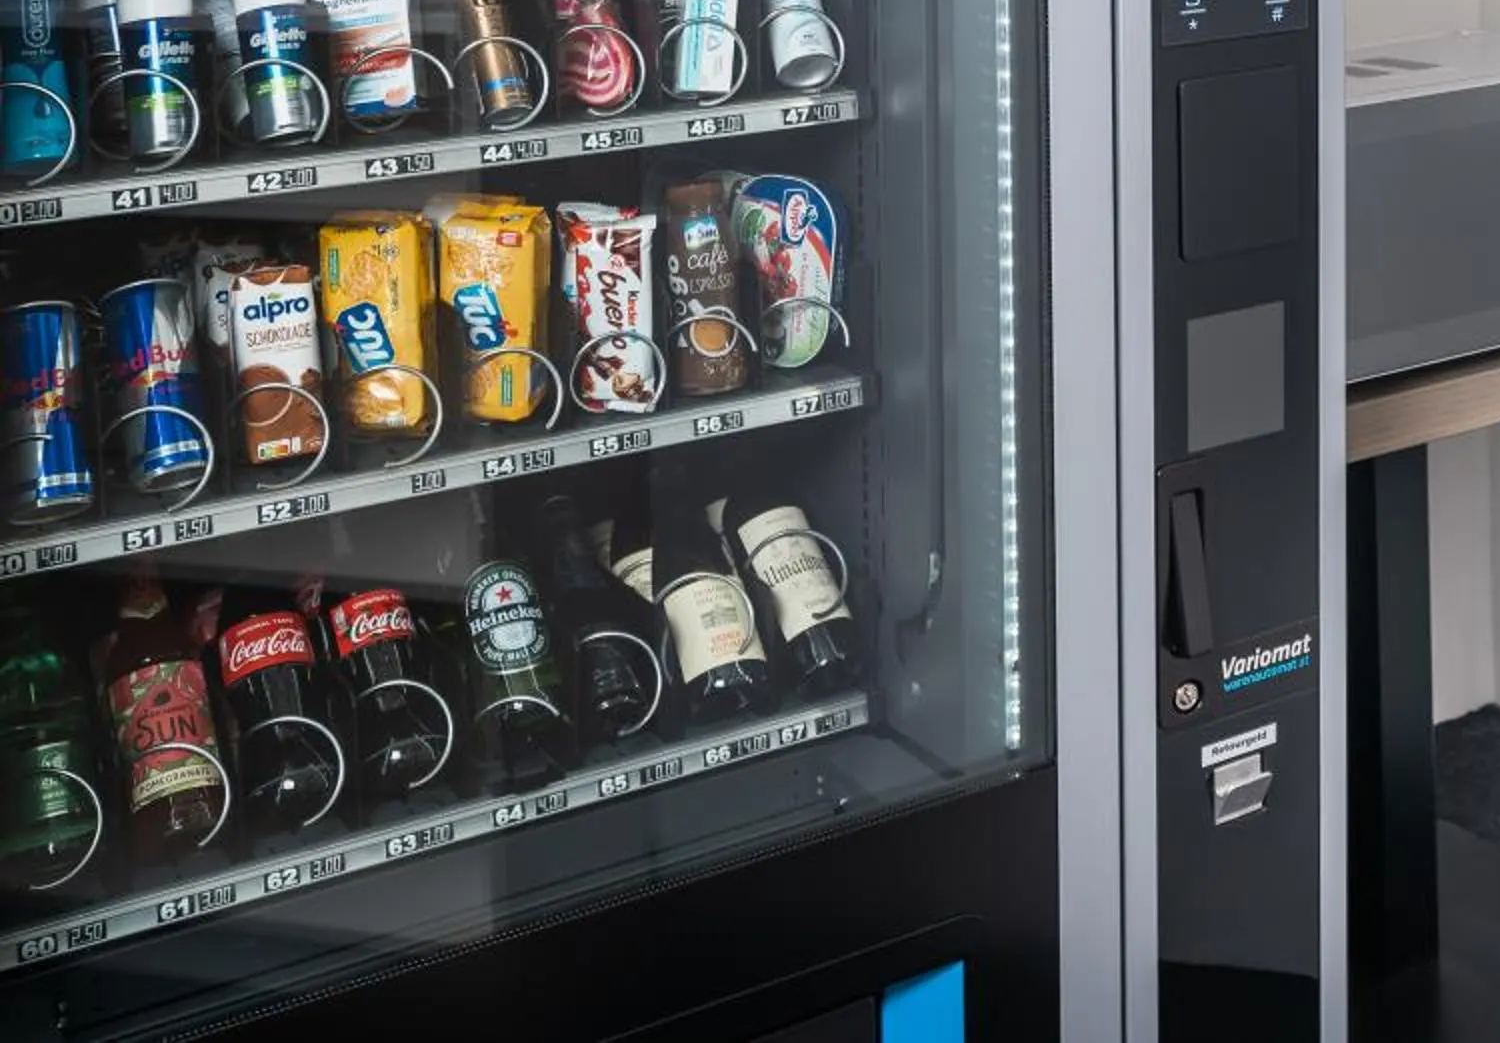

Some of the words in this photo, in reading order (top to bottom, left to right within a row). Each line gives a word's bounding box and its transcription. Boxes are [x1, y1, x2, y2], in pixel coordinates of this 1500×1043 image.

[785, 108, 809, 124] 47
[690, 120, 716, 136] 46
[585, 131, 611, 148] 45
[483, 145, 512, 162] 44
[367, 159, 398, 177] 43
[250, 173, 282, 192] 42
[116, 189, 147, 208] 41
[243, 294, 309, 323] alpro
[598, 270, 627, 350] bueno
[245, 322, 313, 348] SCHOKOLADE
[795, 397, 819, 414] 57
[697, 417, 722, 434] 56
[592, 438, 618, 455] 55
[486, 458, 515, 476] 54
[261, 503, 292, 521] 52
[127, 526, 157, 549] 51
[469, 604, 544, 637] Heineken
[1221, 633, 1312, 680] Variomat
[134, 713, 199, 751] SUN
[781, 724, 807, 744] 67
[1211, 730, 1268, 757] Retourgeld
[705, 745, 731, 765] 66
[601, 774, 627, 794] 65
[495, 804, 522, 825] 64
[388, 834, 416, 855] 63
[267, 868, 298, 890] 62
[160, 896, 190, 920] 61
[21, 935, 55, 959] 60
